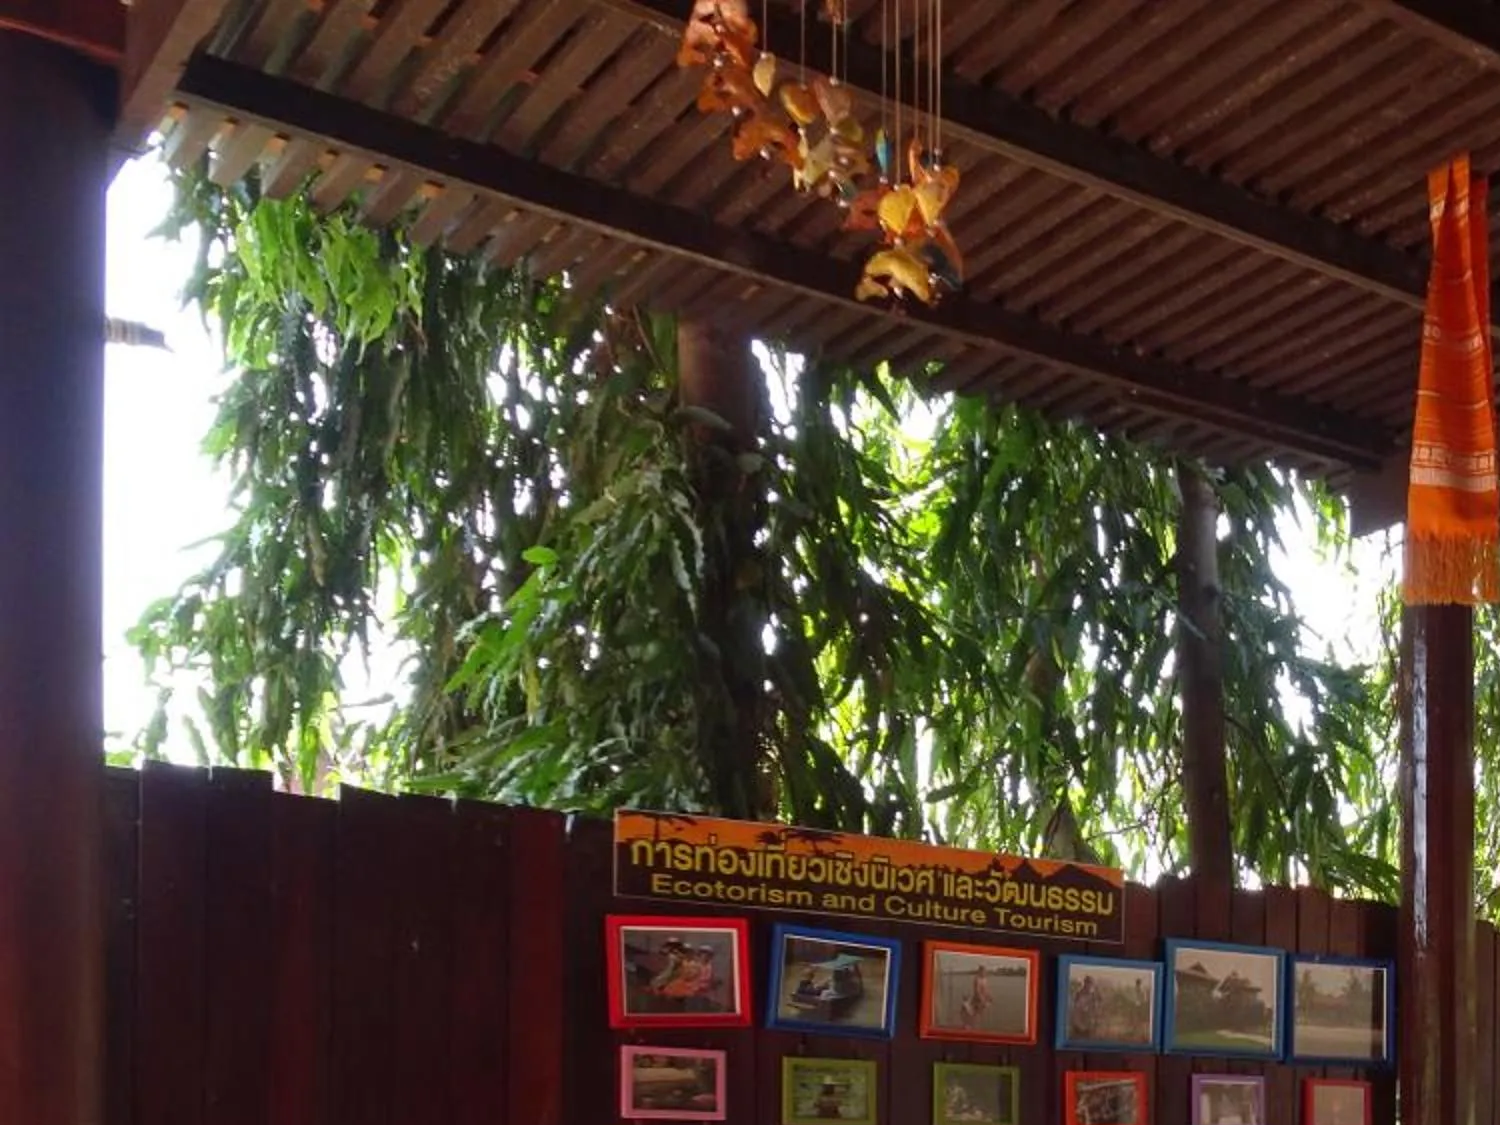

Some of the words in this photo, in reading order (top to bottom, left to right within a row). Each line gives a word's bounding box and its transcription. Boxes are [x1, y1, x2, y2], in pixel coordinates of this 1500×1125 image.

[651, 873, 813, 906] Ecotorism
[822, 893, 876, 912] and
[885, 895, 988, 924] Culture
[994, 907, 1098, 936] Tourism
[943, 870, 1114, 916] และวัฒนธรรม
